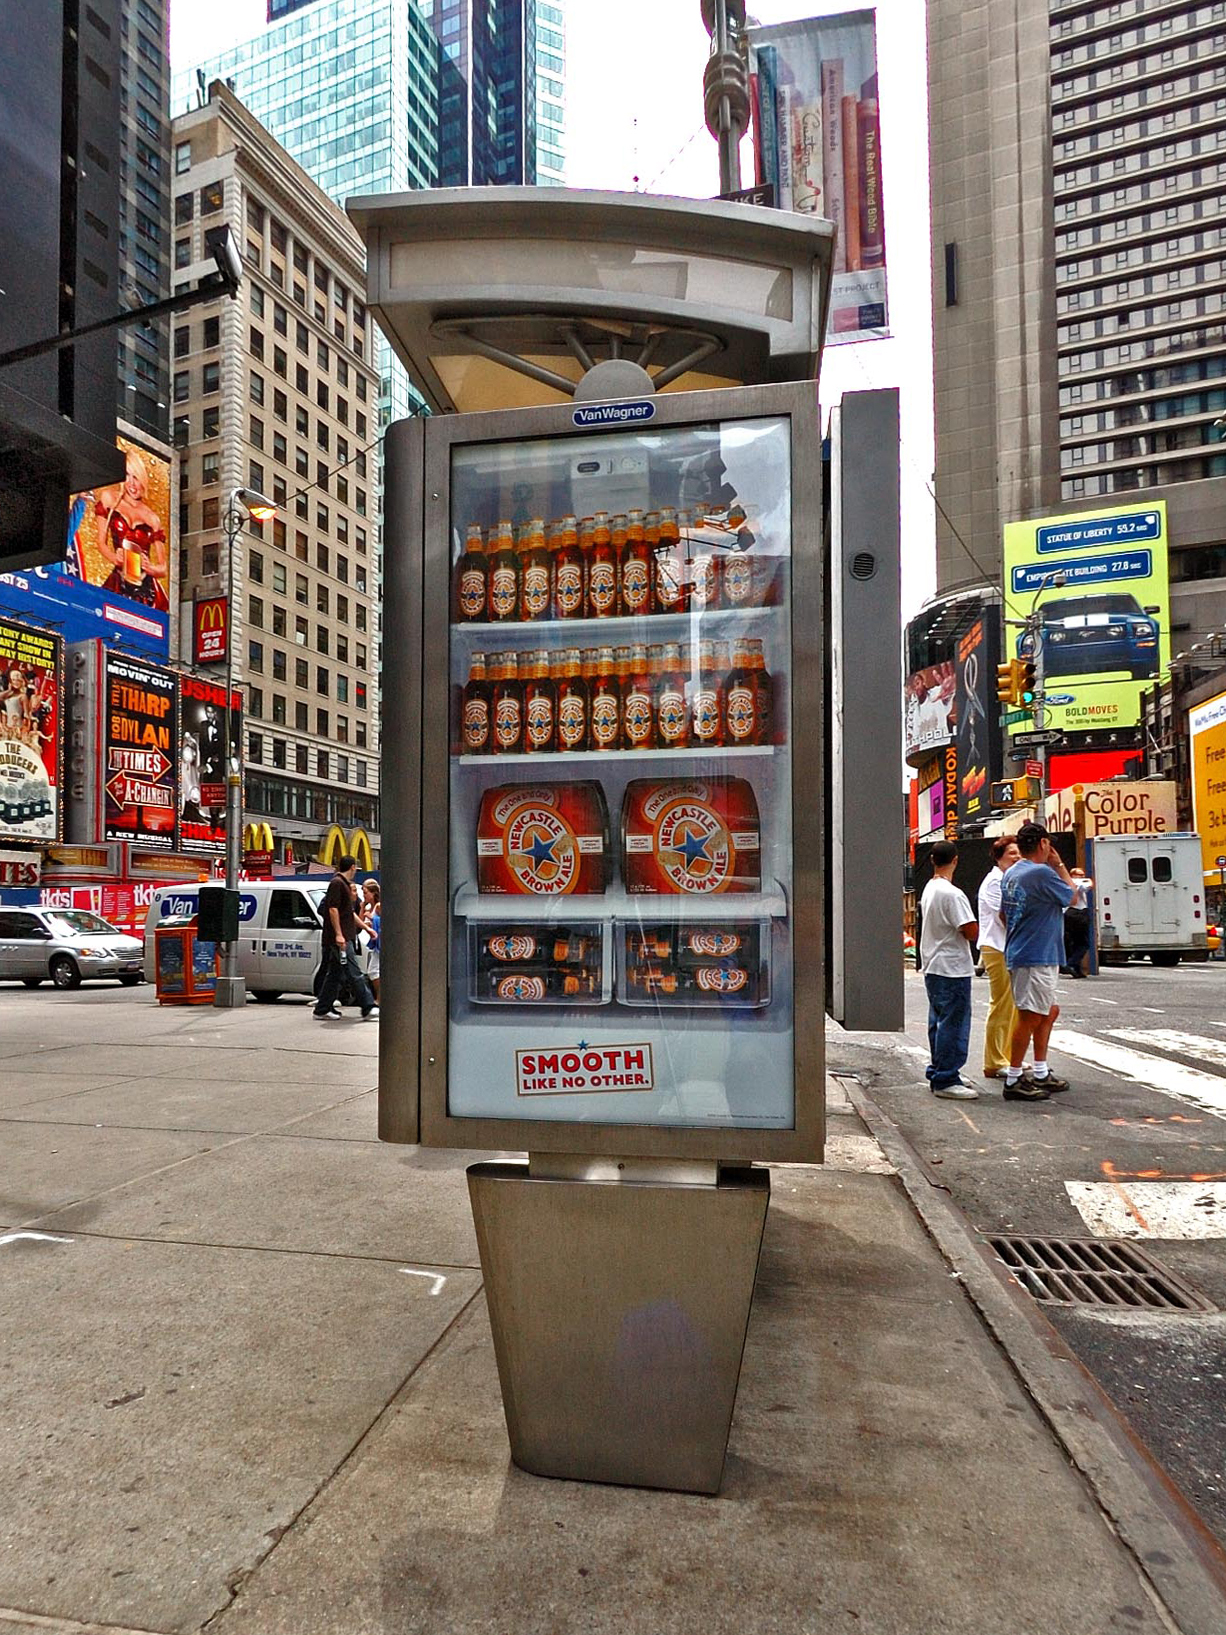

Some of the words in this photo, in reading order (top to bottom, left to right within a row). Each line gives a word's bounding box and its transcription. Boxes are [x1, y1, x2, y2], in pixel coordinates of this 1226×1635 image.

[866, 130, 875, 151] The
[204, 638, 220, 650] 24
[151, 677, 175, 690] OUT
[121, 686, 171, 718] THARP
[121, 717, 170, 749] DYLAN
[5, 742, 21, 755] THE
[122, 751, 161, 774] TIMES
[945, 747, 957, 805] KODAK
[498, 803, 511, 817] The
[648, 801, 660, 813] The
[1085, 790, 1150, 814] Color
[511, 812, 563, 850] NEWCASTLE
[661, 807, 717, 847] NEWCASTLE
[1094, 809, 1166, 835] Purple
[520, 870, 566, 893] BROWN
[562, 854, 573, 879] ALE
[671, 866, 719, 890] BROWN
[715, 852, 727, 876] ALE
[40, 888, 70, 908] tkts
[166, 895, 194, 914] Van
[522, 1049, 644, 1075] SMOOTH
[523, 1074, 557, 1090] LIKE
[562, 1074, 586, 1088] NO
[590, 1072, 650, 1087] OTHER.
